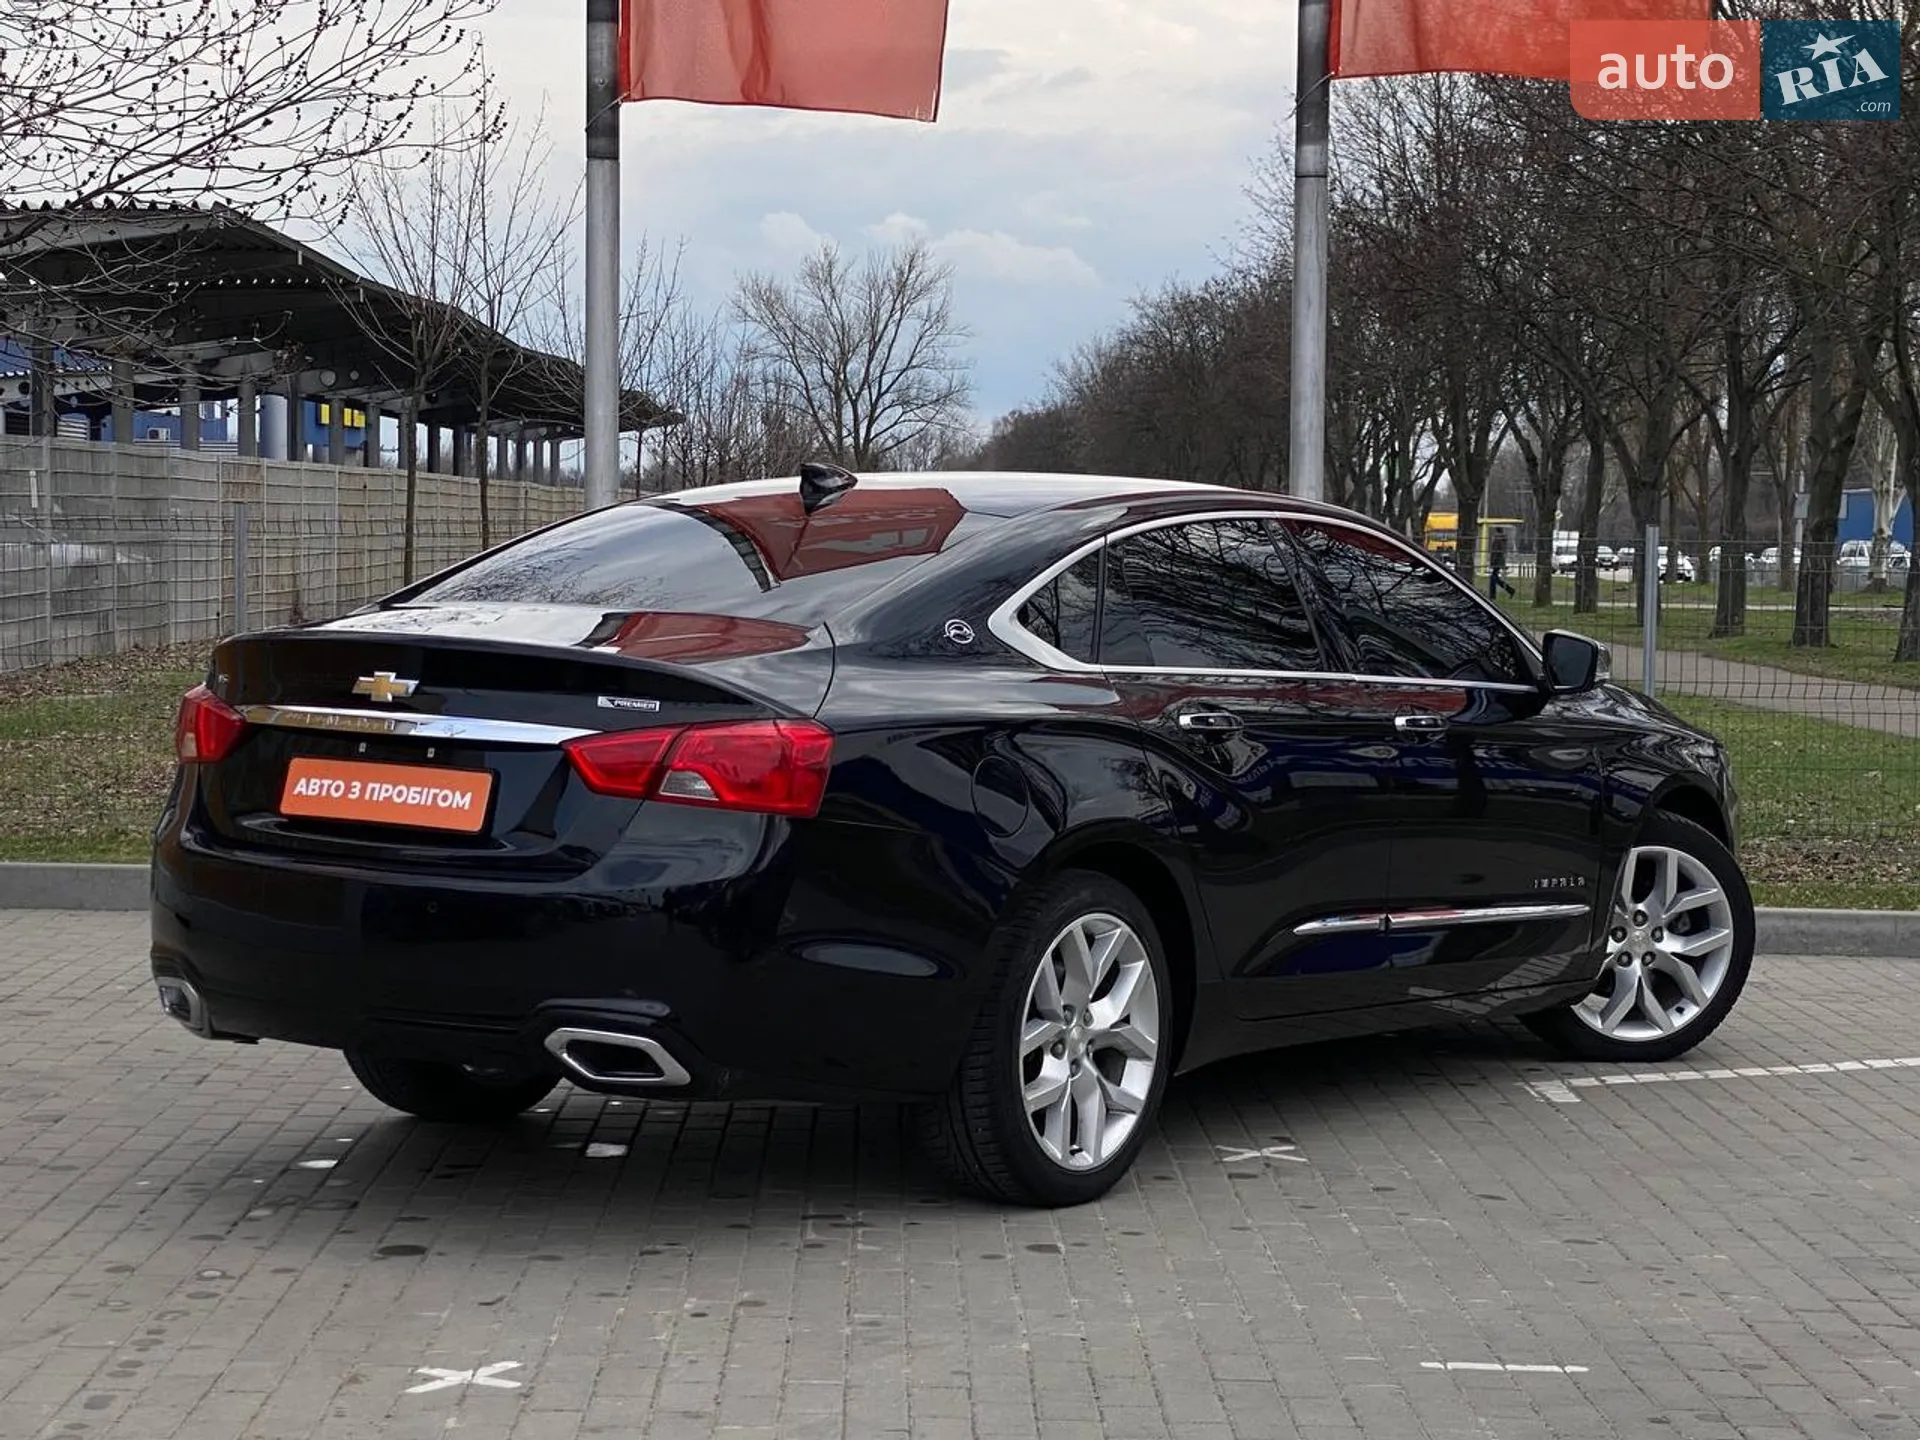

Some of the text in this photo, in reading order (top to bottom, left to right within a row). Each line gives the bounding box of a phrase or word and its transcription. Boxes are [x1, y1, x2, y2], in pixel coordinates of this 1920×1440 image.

[613, 699, 656, 710] PREMIER
[293, 777, 473, 810] АВТО З ПРОБІГОМ
